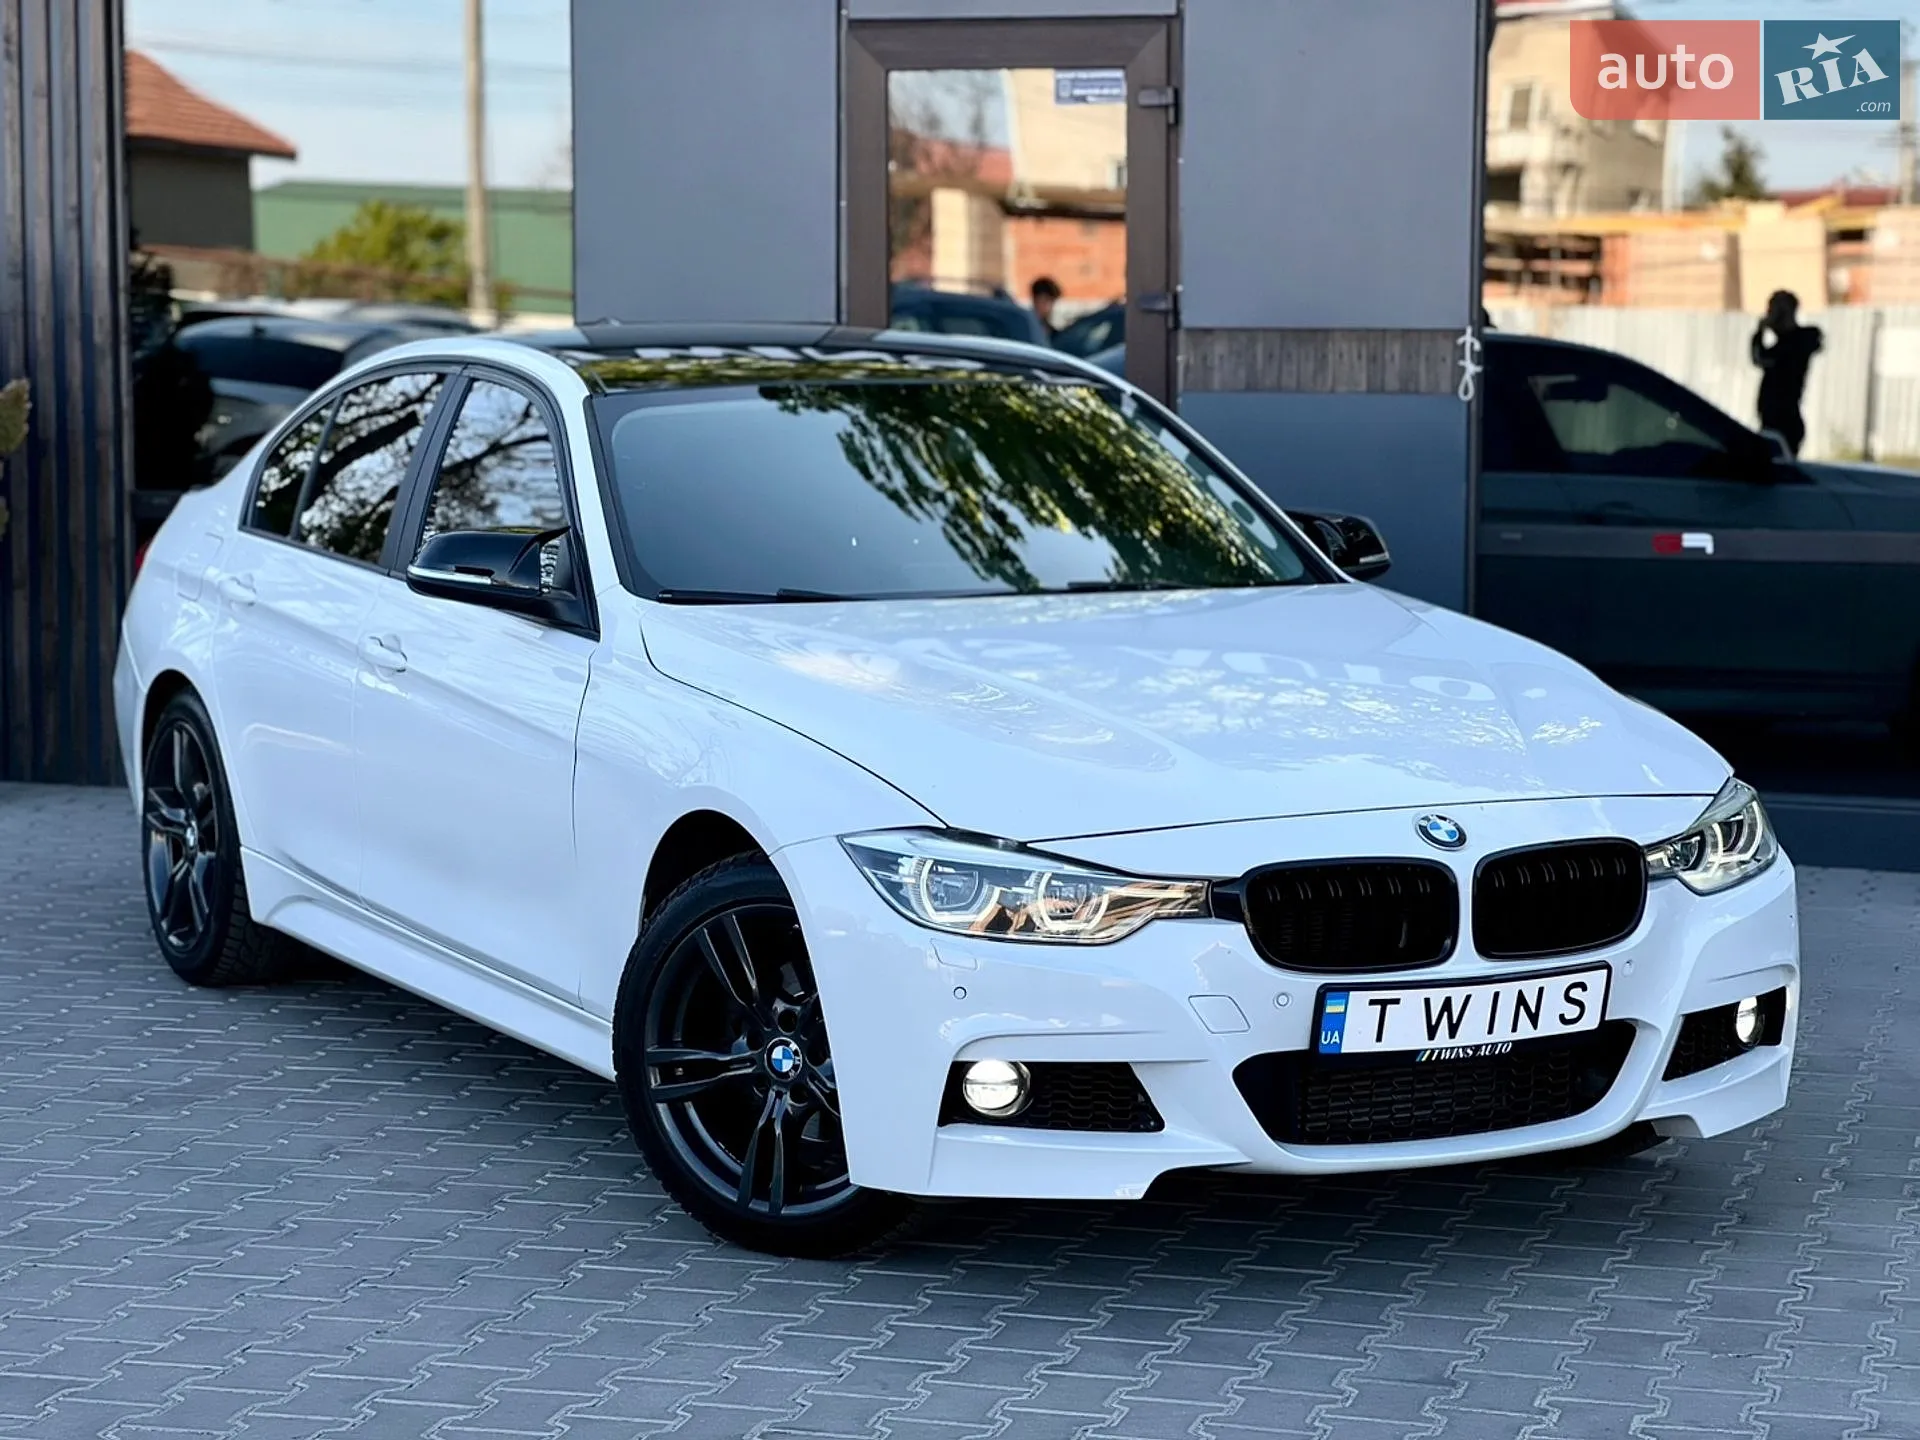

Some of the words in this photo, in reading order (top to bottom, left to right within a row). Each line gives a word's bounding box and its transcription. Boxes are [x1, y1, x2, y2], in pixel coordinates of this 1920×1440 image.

[1321, 1030, 1341, 1046] UA
[1430, 1045, 1474, 1060] TWINS
[1476, 1042, 1512, 1057] AUTO
